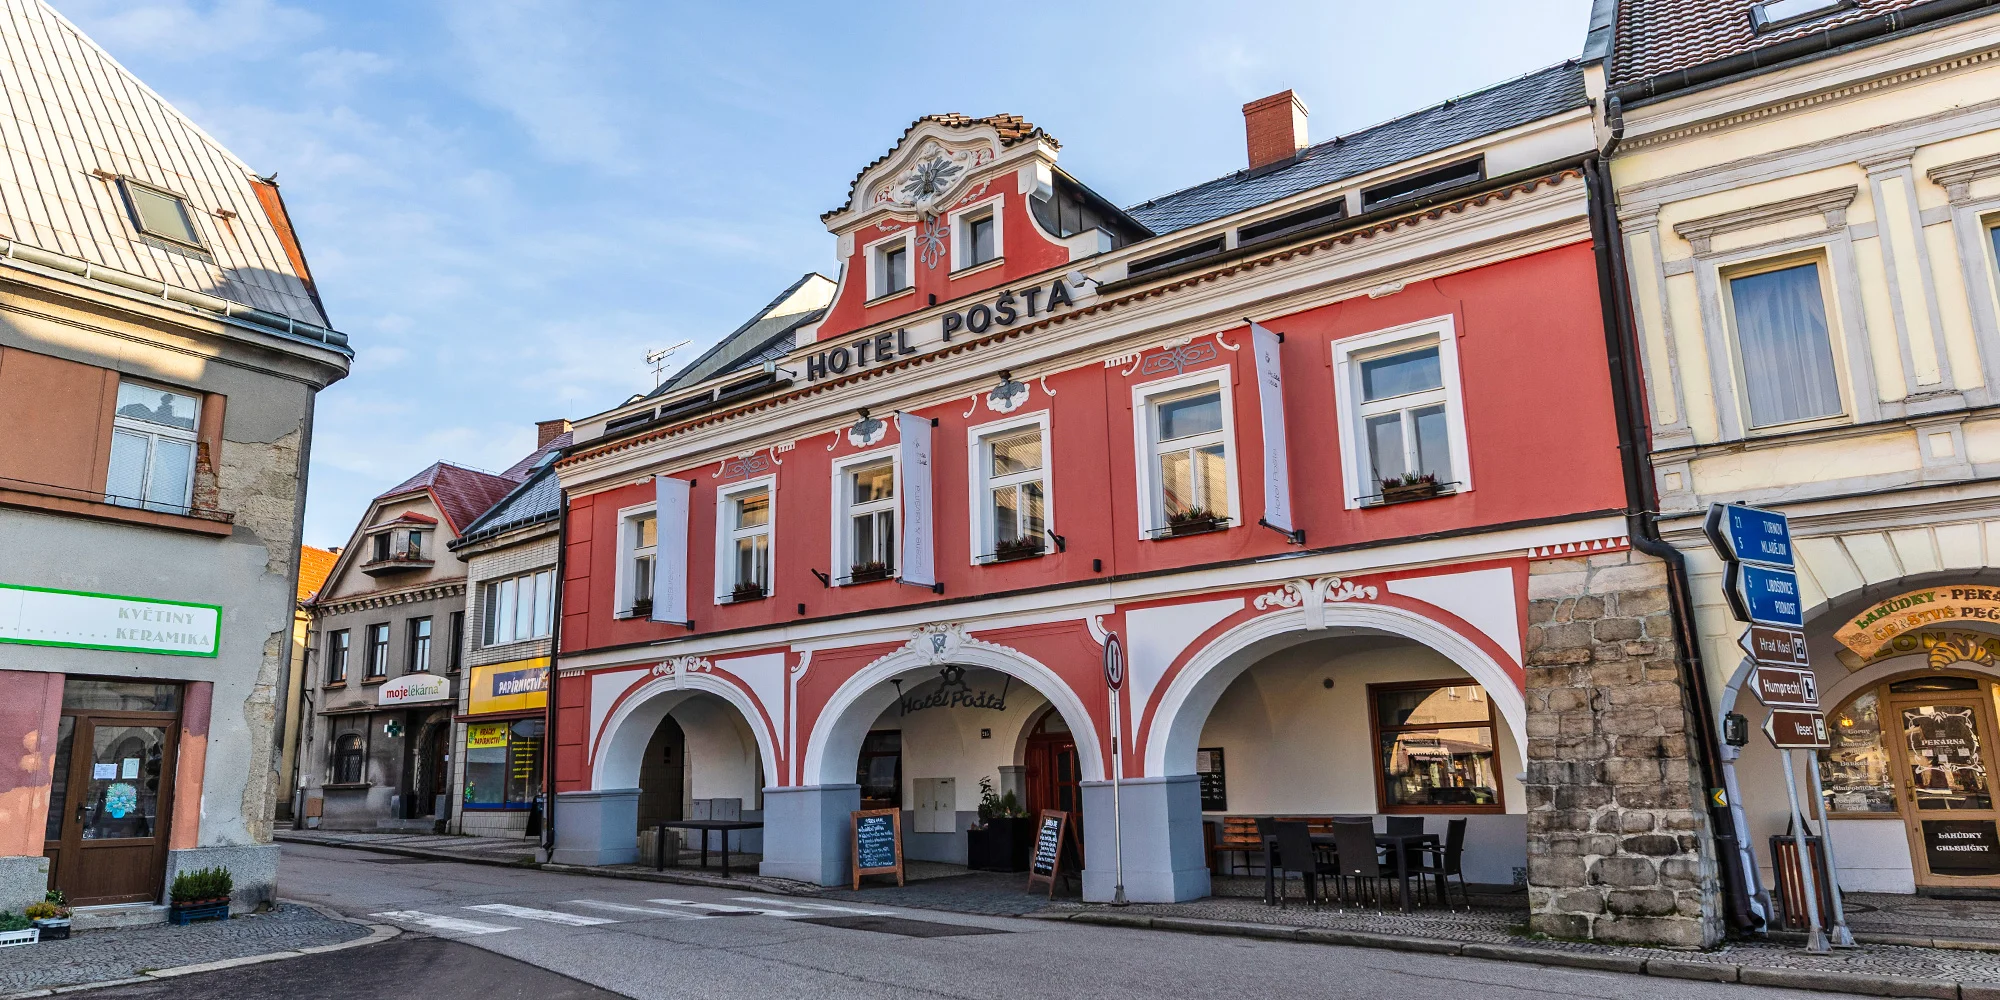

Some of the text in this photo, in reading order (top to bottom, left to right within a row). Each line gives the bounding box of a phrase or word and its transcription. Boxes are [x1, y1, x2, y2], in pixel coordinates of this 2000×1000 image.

[807, 278, 1074, 381] HOTEL POŠTA
[1763, 520, 1783, 535] TURNOV
[1738, 536, 1786, 556] 5 MLADĚJOV
[1747, 575, 1794, 595] 5 LIBOŠOVICE
[118, 606, 195, 625] KVĚTINY
[1774, 600, 1796, 616] PODKOST
[1855, 590, 1936, 630] LAHŮDKY
[116, 627, 210, 646] KERAMIKA
[1760, 637, 1791, 654] Hrad Kost
[1762, 678, 1801, 697] Humprecht
[900, 690, 1006, 717] Hotel Pošta
[1794, 722, 1813, 736] Vesec
[1921, 737, 1966, 746] PEKÁRNA
[1938, 831, 1982, 840] LAHŮDKY
[1936, 844, 1989, 853] CHLEBÍČKY
